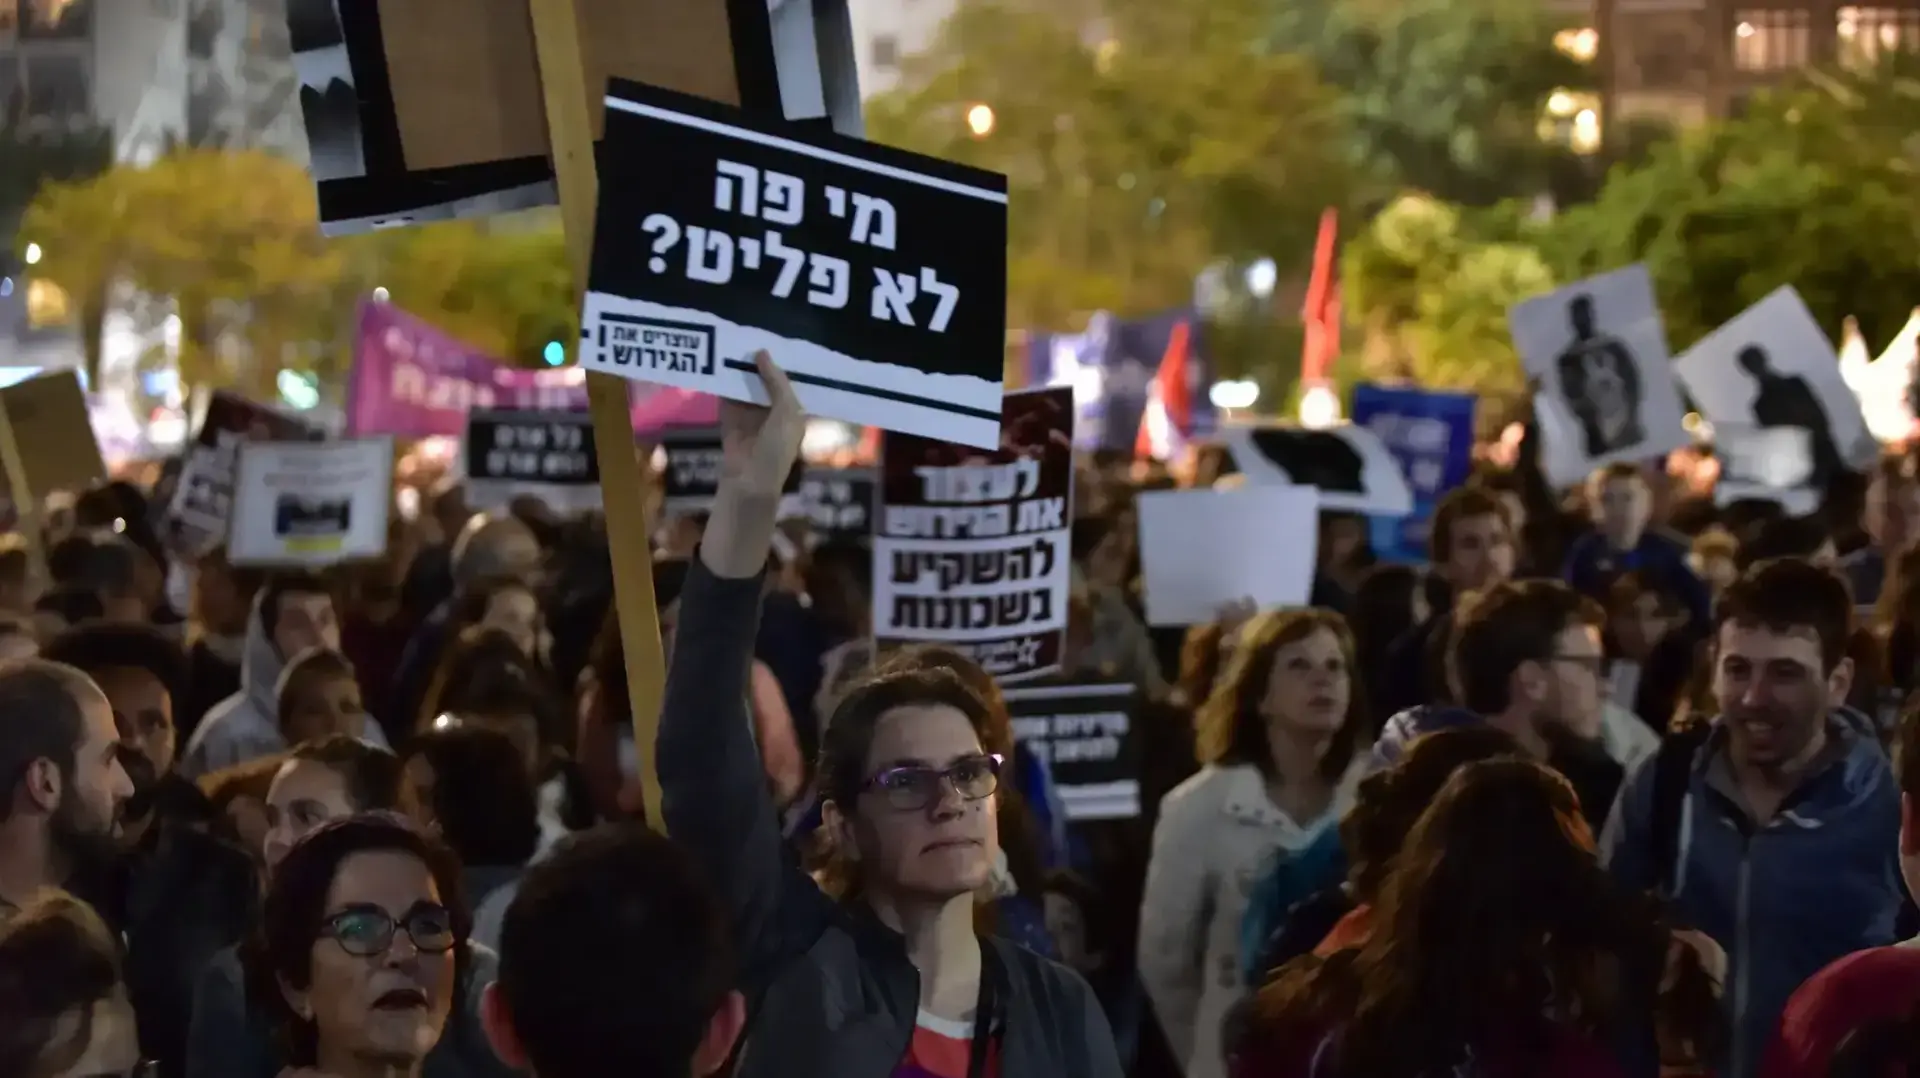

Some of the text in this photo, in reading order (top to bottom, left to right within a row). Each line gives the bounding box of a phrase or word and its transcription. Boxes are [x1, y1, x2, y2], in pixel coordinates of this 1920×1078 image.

[714, 158, 897, 250] מי פה
[641, 213, 960, 333] לא פליט?
[612, 325, 700, 350] עוצרים את
[914, 455, 1040, 503] לעצור
[1016, 497, 1064, 533] את
[890, 538, 1055, 591] להשקיע
[889, 588, 1052, 629] בשכונות
